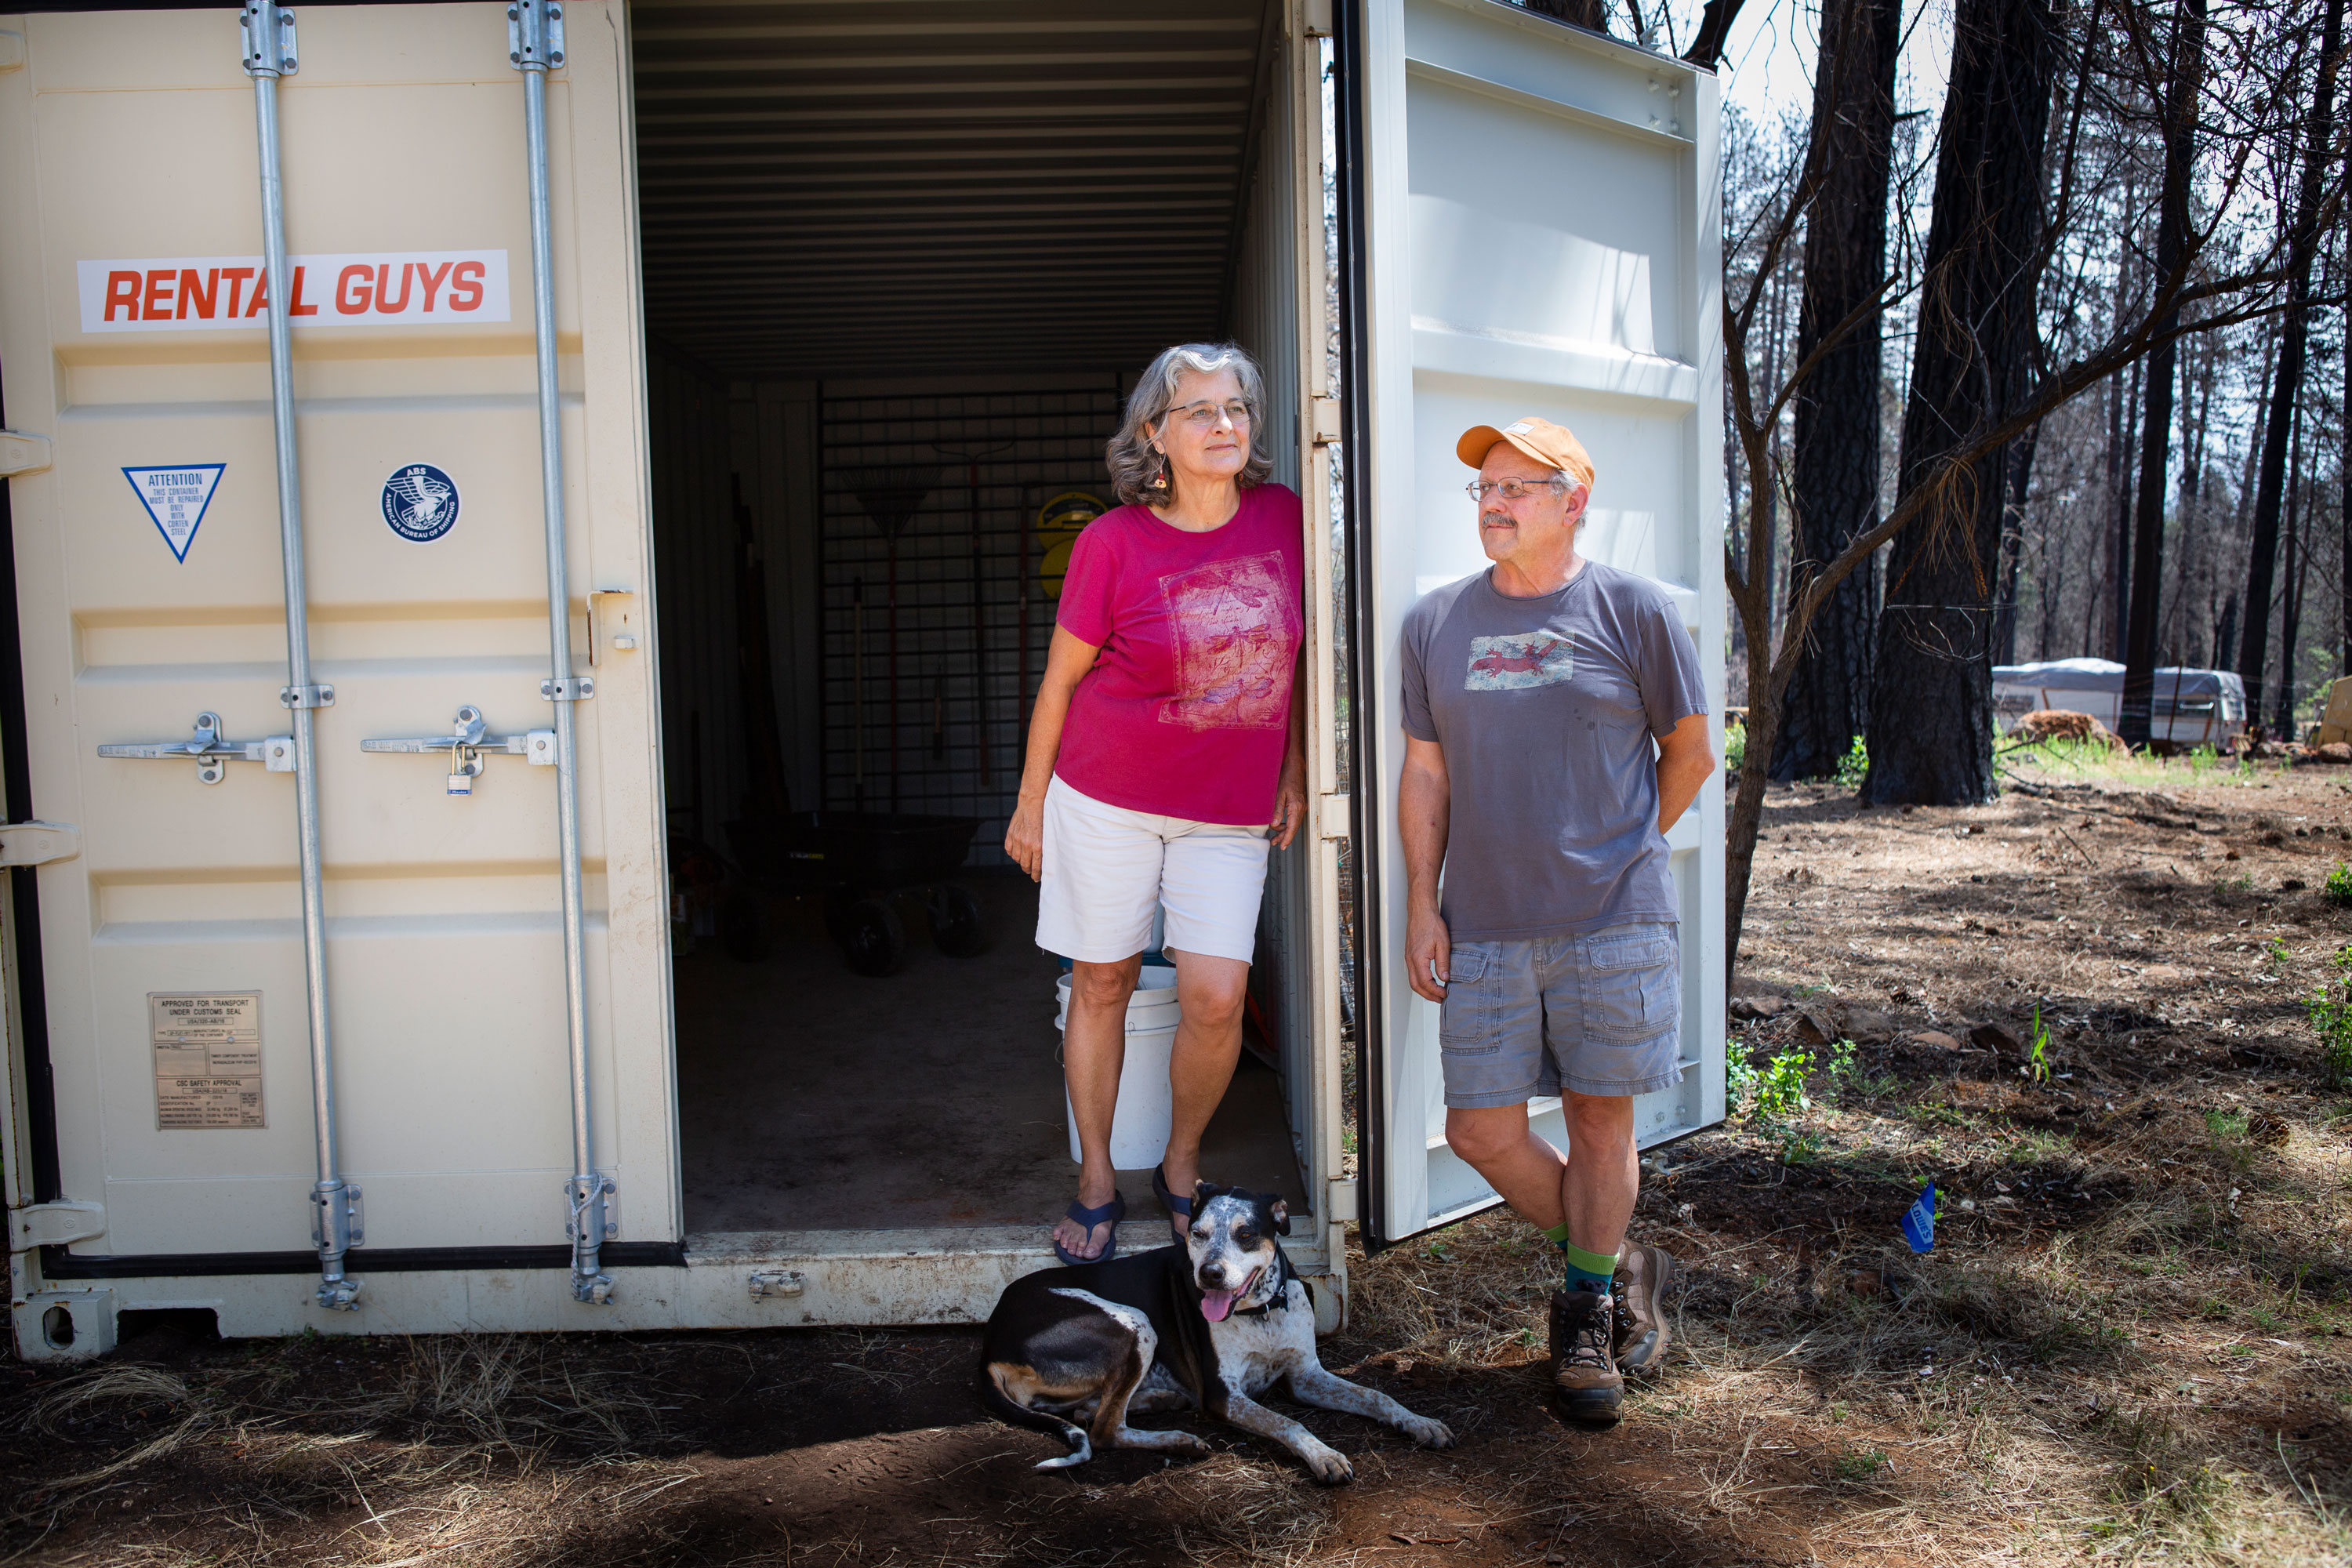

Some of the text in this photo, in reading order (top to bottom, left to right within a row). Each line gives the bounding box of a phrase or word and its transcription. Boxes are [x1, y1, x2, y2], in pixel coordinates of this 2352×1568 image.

[103, 260, 485, 322] RENTAL GUYS
[148, 473, 202, 486] ATTENTION
[407, 467, 426, 477] ABS
[168, 487, 199, 495] CONTAINER
[385, 493, 456, 538] AMERICAN BUREAU OF SHIPPING
[1911, 1203, 1933, 1240] LOWE'S
